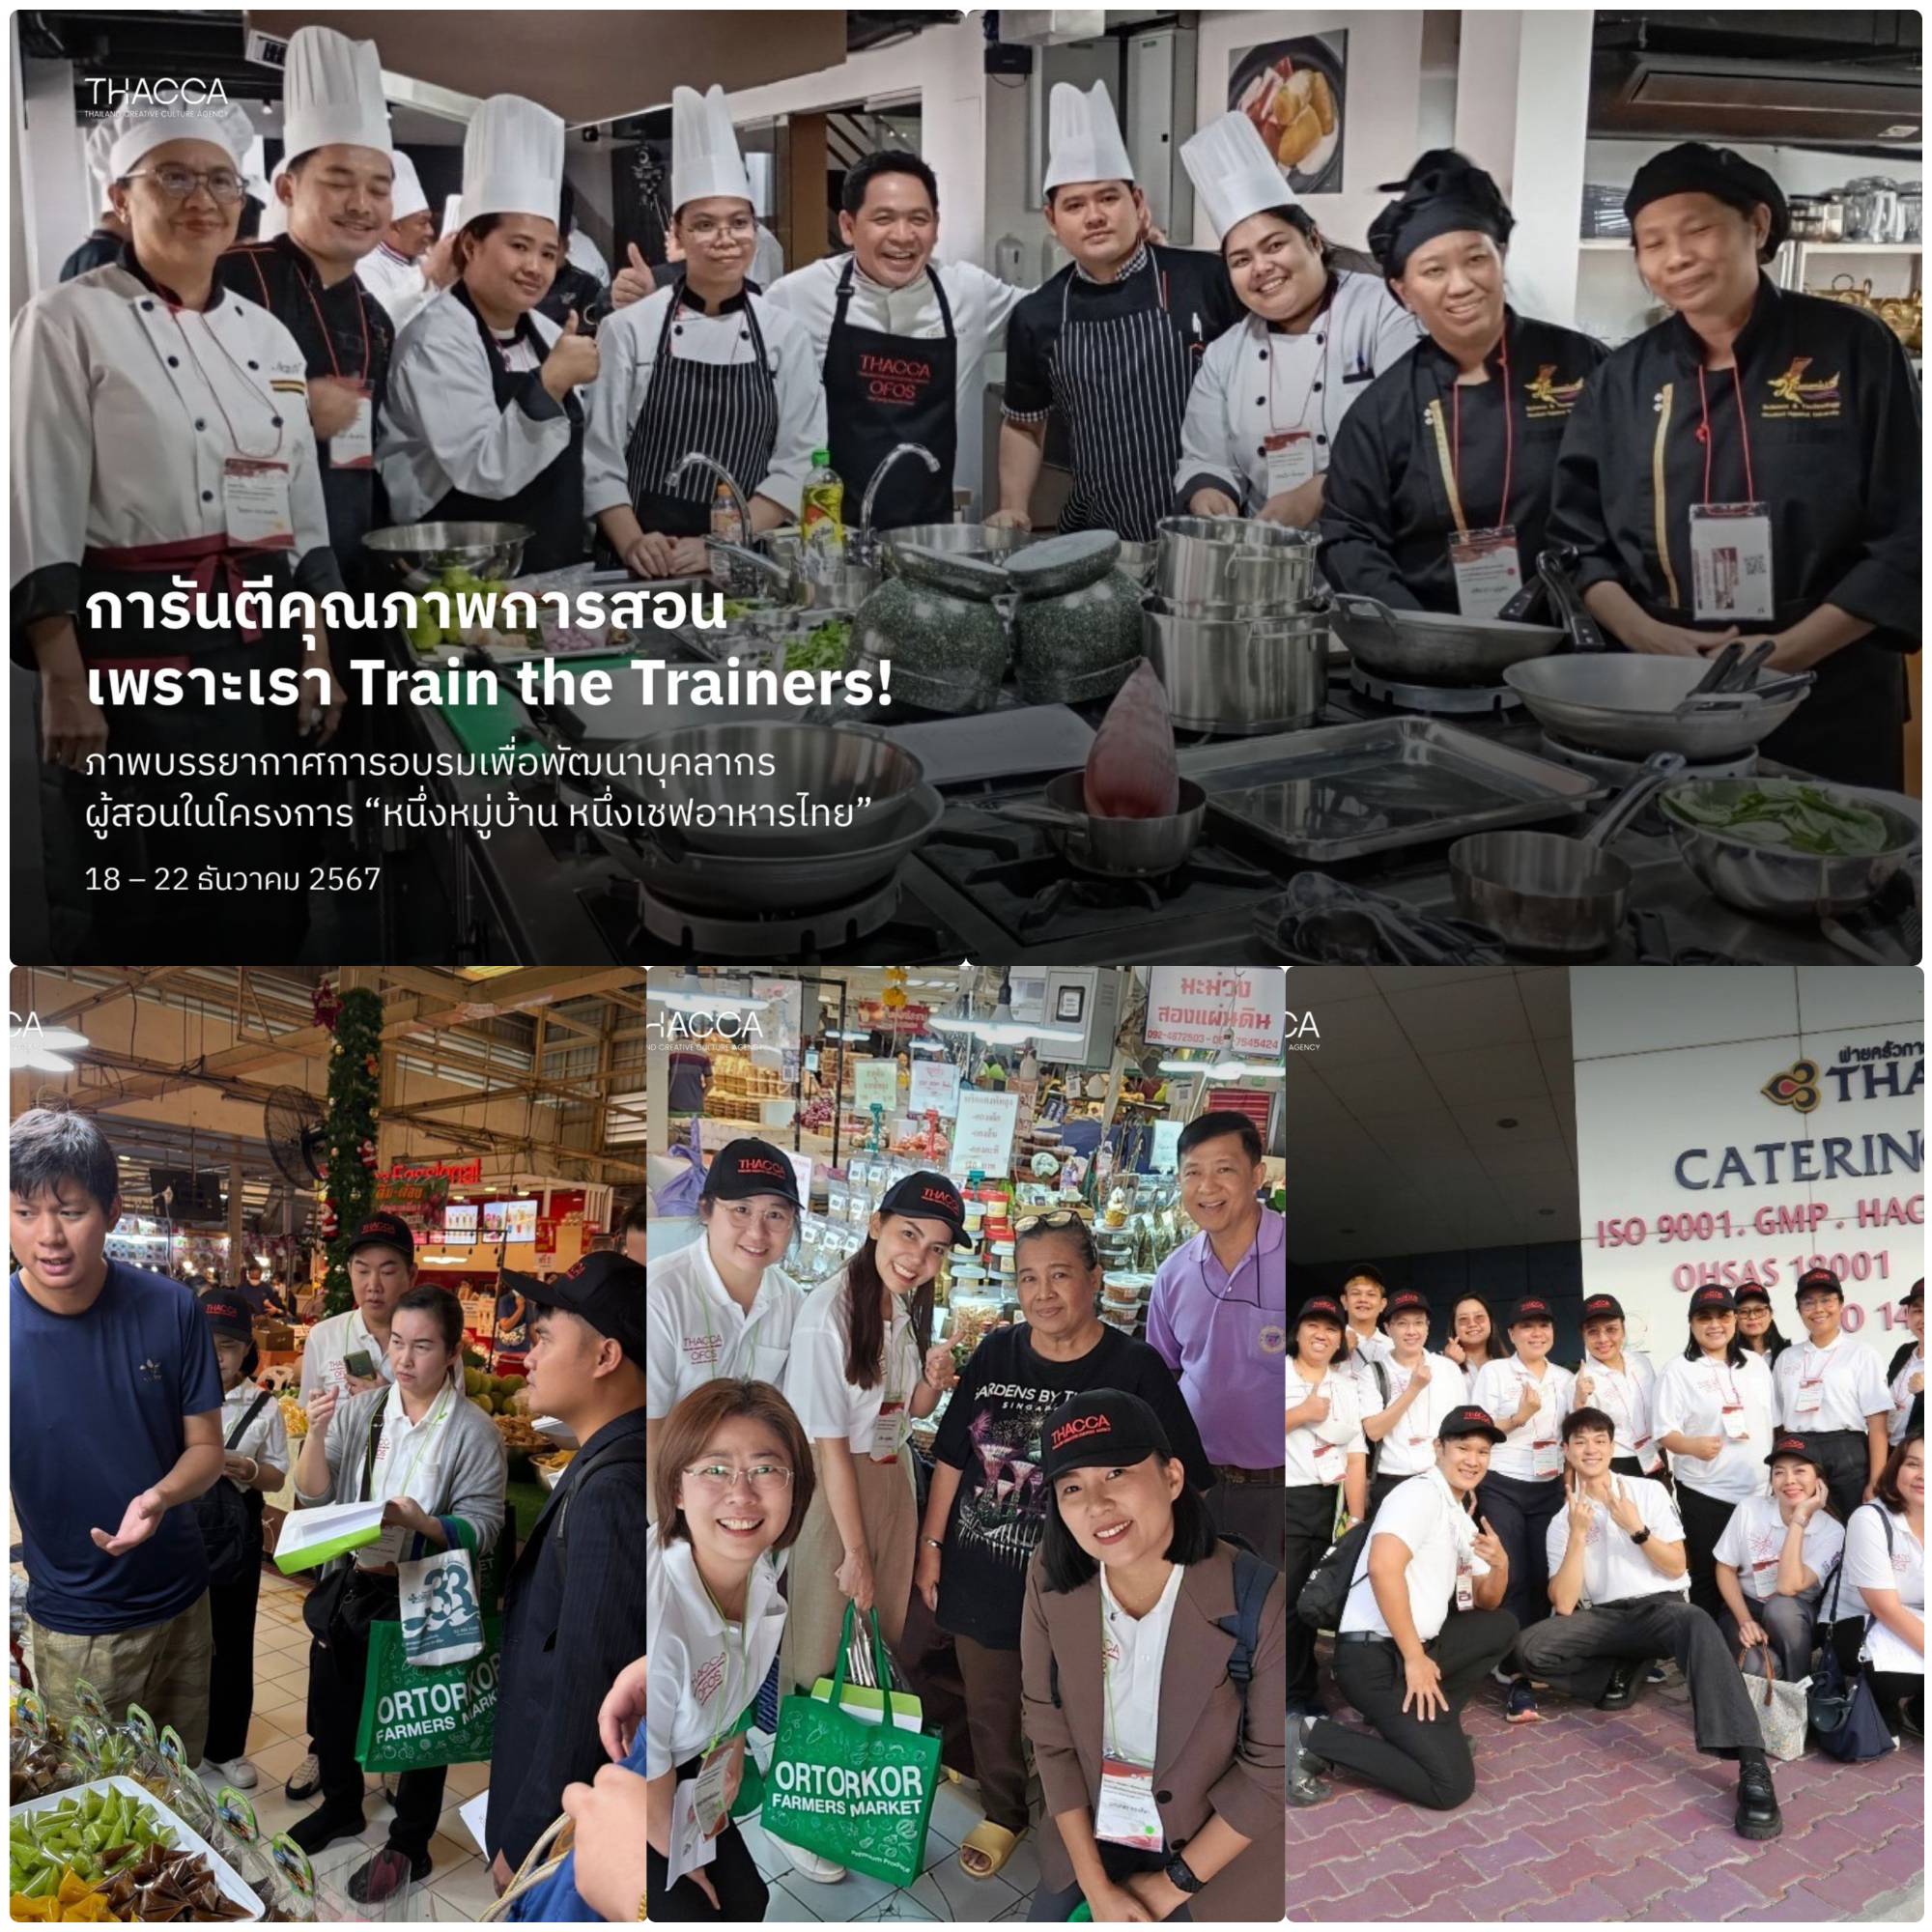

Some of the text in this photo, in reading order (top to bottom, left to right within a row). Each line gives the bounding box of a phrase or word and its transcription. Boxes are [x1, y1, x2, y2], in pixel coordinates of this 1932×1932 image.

[861, 355, 931, 378] THACCA
[869, 380, 916, 399] OFOS
[1180, 971, 1253, 999] มะม่วง
[1157, 1003, 1273, 1031] สองแผ่นดิน
[737, 1158, 784, 1176] THACCA
[1674, 1129, 1924, 1191] CATERIN
[1597, 1216, 1647, 1249] ISO
[1754, 1203, 1830, 1236] GMP
[1673, 1257, 1780, 1293] OHSAS
[683, 1334, 723, 1348] THACCA
[1038, 1389, 1062, 1403] BY
[1051, 1414, 1111, 1445] THACCA
[375, 1689, 499, 1745] FARMERS MARK
[775, 1760, 923, 1800] ORTORKOR
[772, 1793, 923, 1818] FARMERS MARKET
